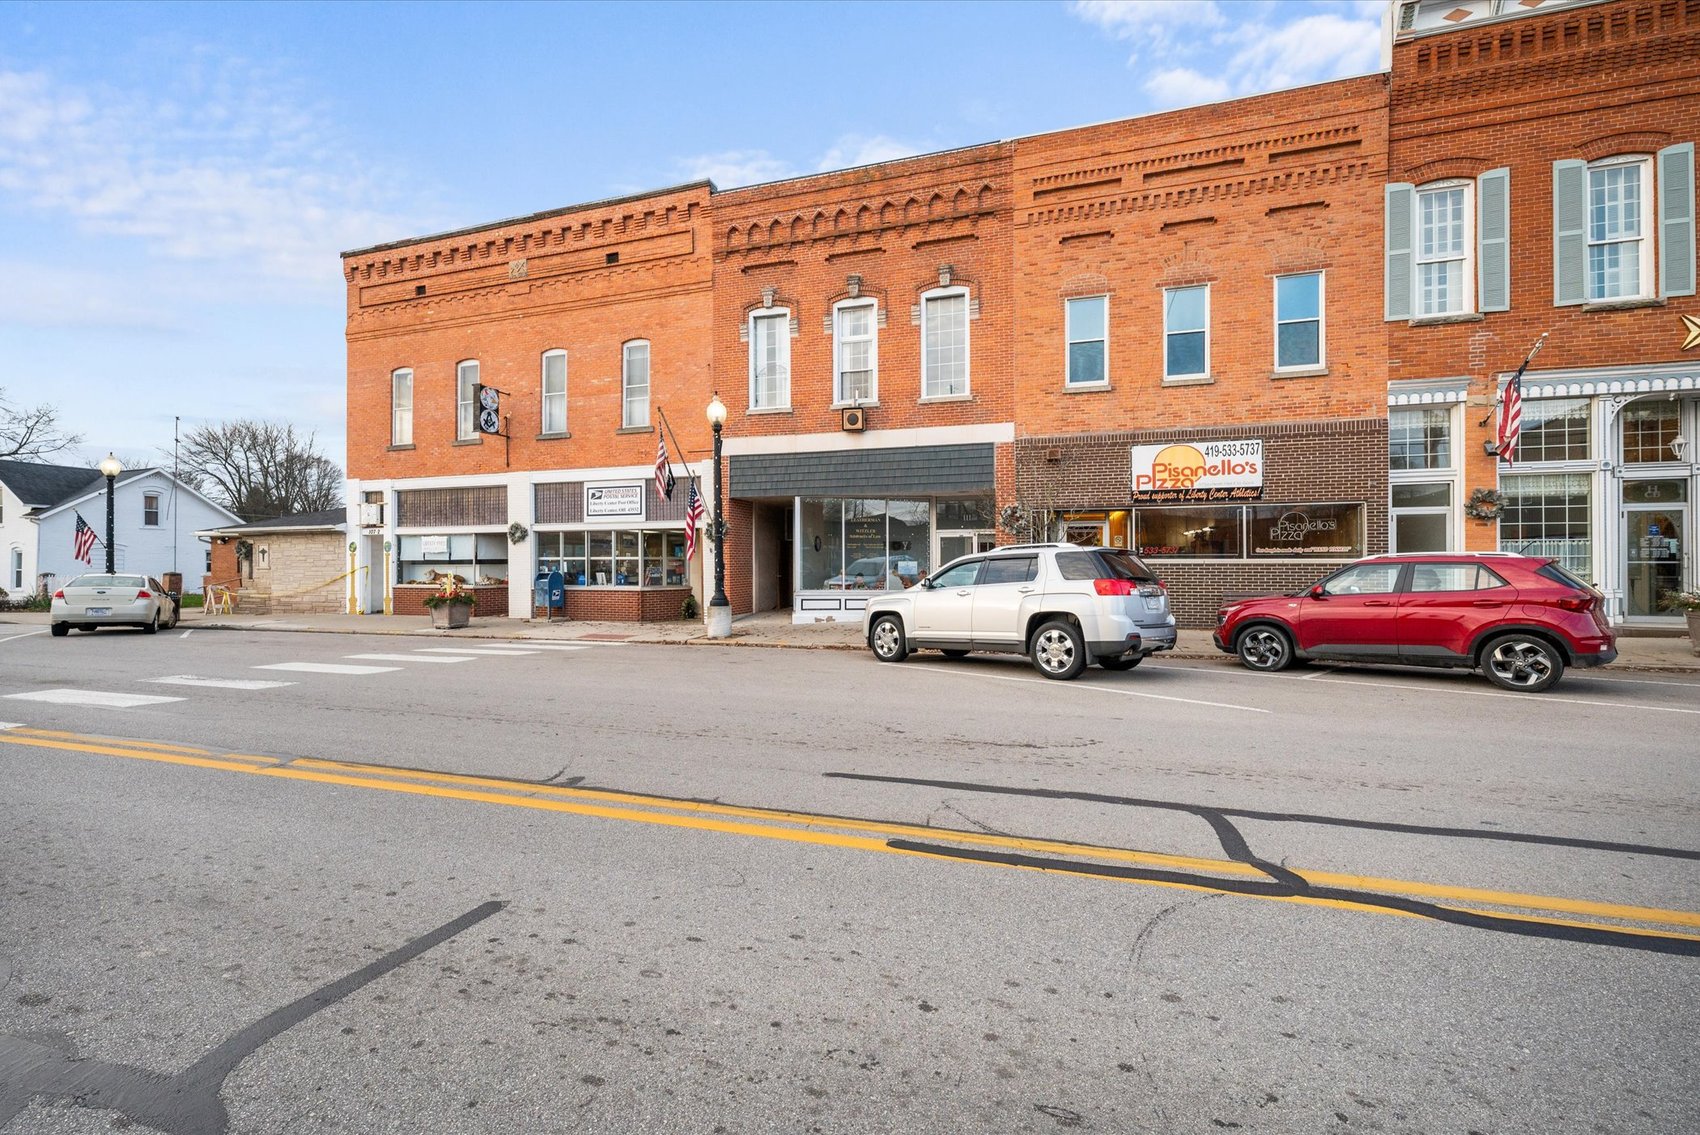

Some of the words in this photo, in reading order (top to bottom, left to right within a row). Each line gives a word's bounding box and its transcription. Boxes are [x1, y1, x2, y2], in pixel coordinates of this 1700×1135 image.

[1204, 442, 1260, 458] 419-533-5737
[1151, 459, 1258, 479] Pisanello's
[1132, 490, 1151, 503] Proud
[1152, 491, 1178, 502] supporter
[1178, 489, 1185, 502] of
[1185, 487, 1208, 501] Liberty
[1208, 486, 1229, 500] Center
[1278, 519, 1336, 530] Pisanello's
